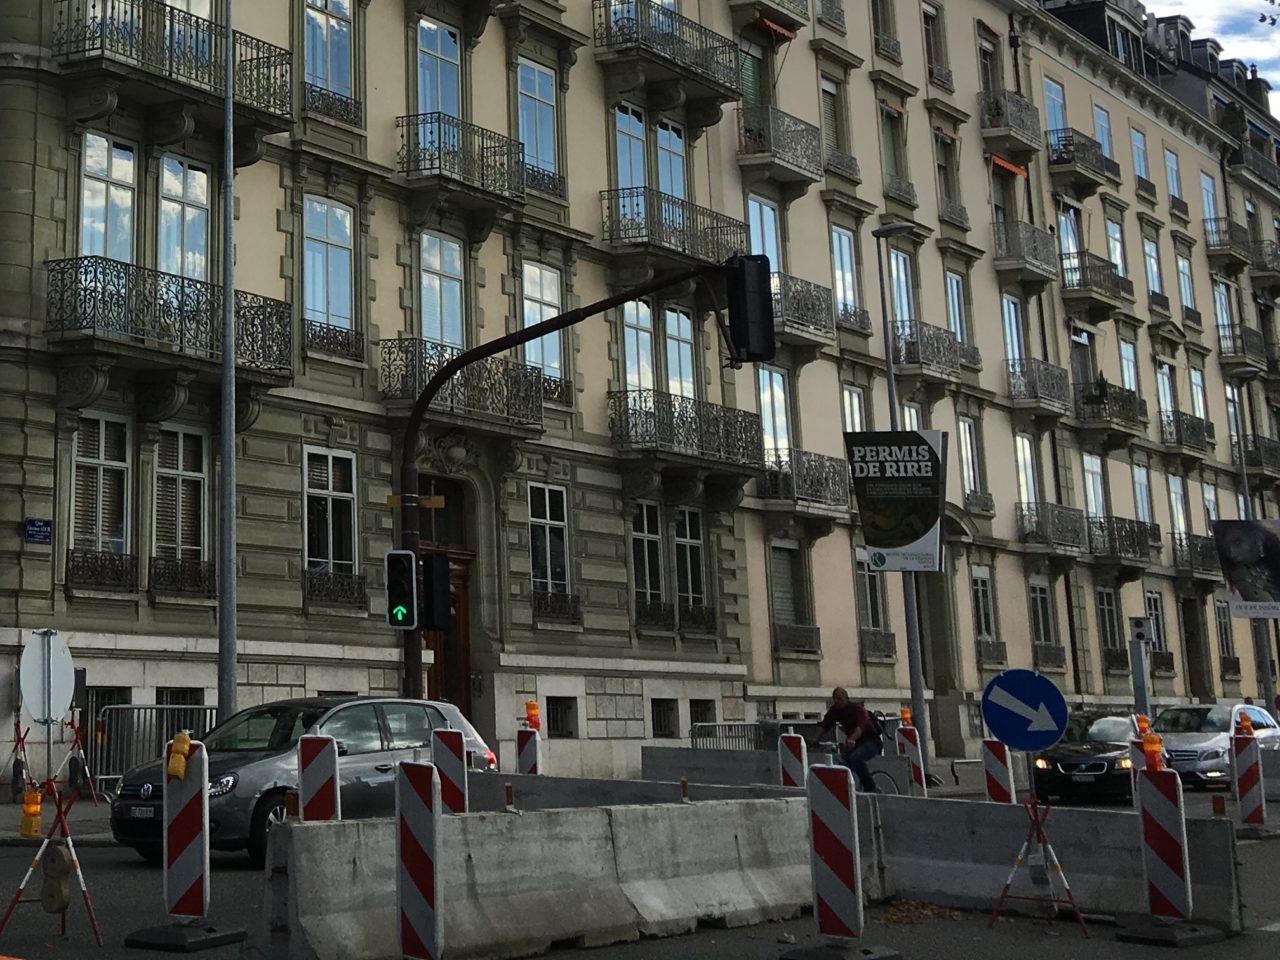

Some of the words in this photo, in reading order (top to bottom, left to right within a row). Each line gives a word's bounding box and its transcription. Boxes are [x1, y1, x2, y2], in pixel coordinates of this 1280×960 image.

[852, 445, 930, 461] PERMIS
[854, 461, 881, 477] DE
[884, 461, 933, 477] RIRE
